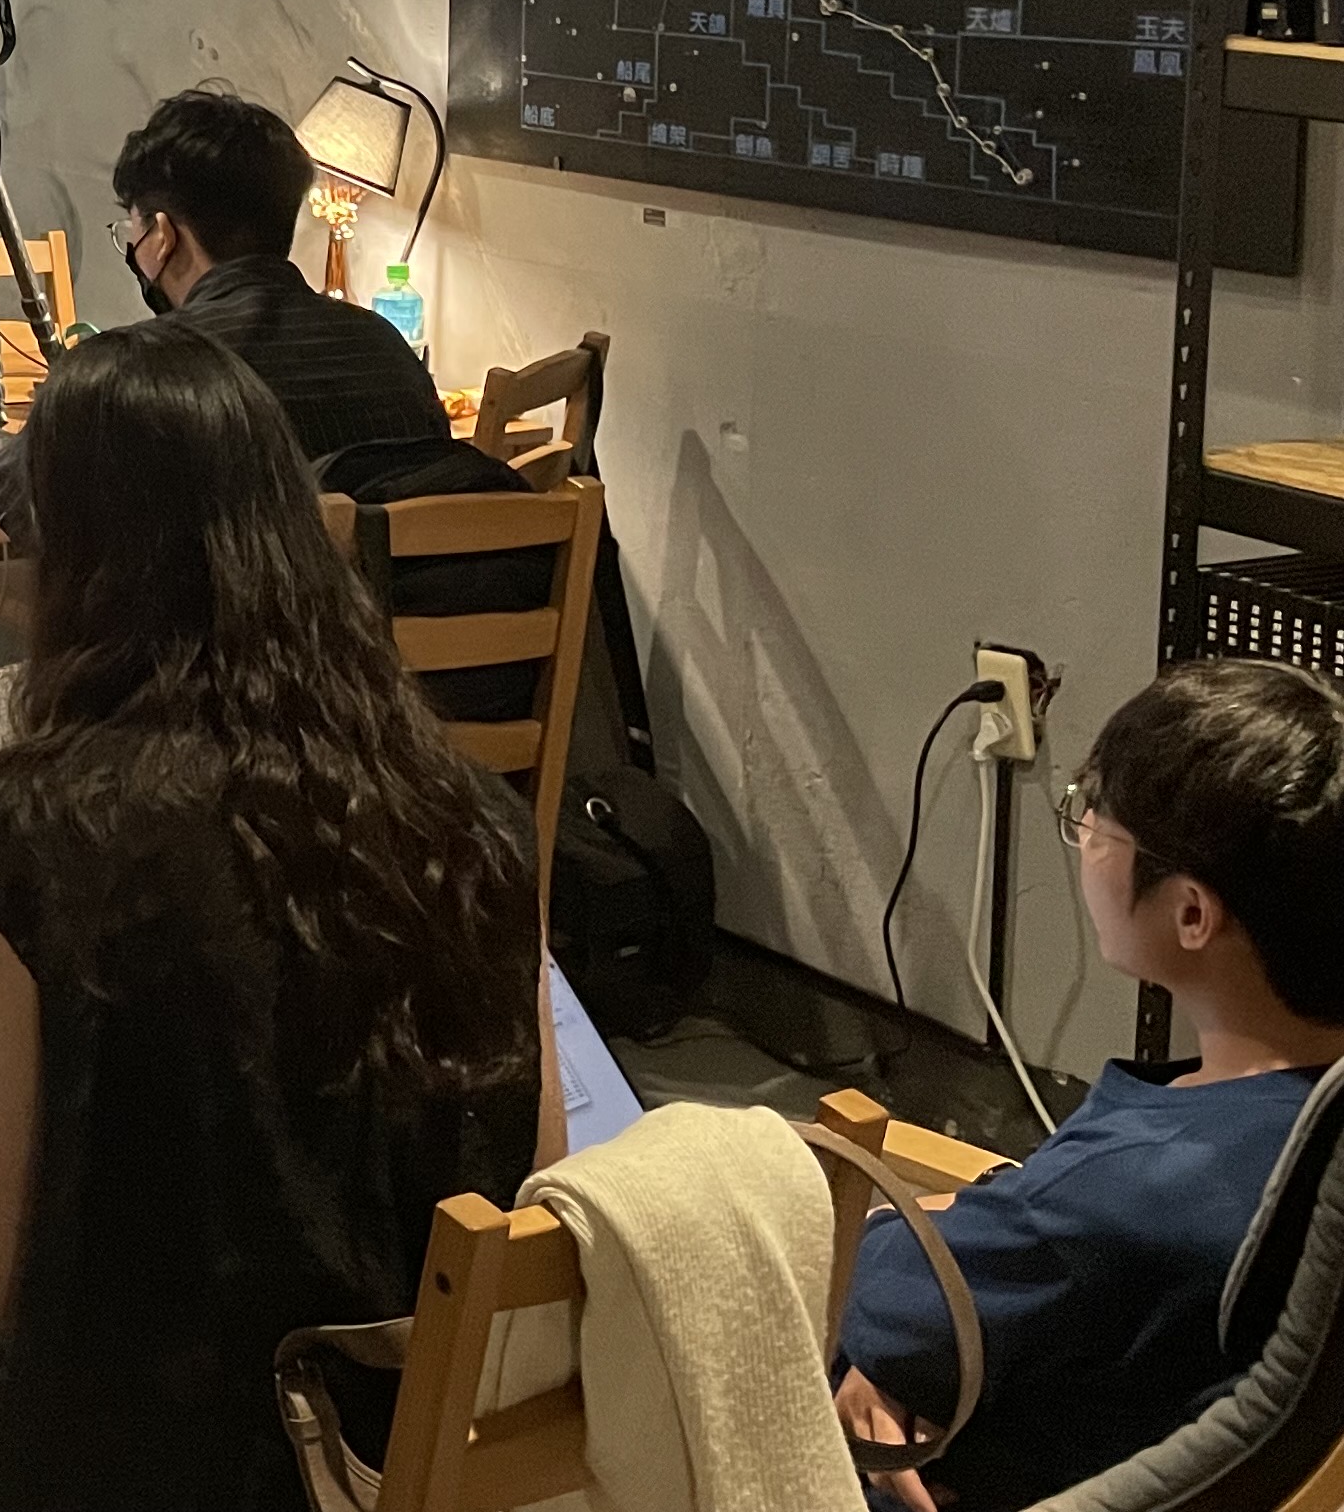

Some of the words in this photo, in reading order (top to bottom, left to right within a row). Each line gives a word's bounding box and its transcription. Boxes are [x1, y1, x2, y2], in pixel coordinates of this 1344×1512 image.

[1136, 15, 1185, 42] 玉夫
[616, 60, 651, 84] 船尾
[523, 105, 556, 128] 船底
